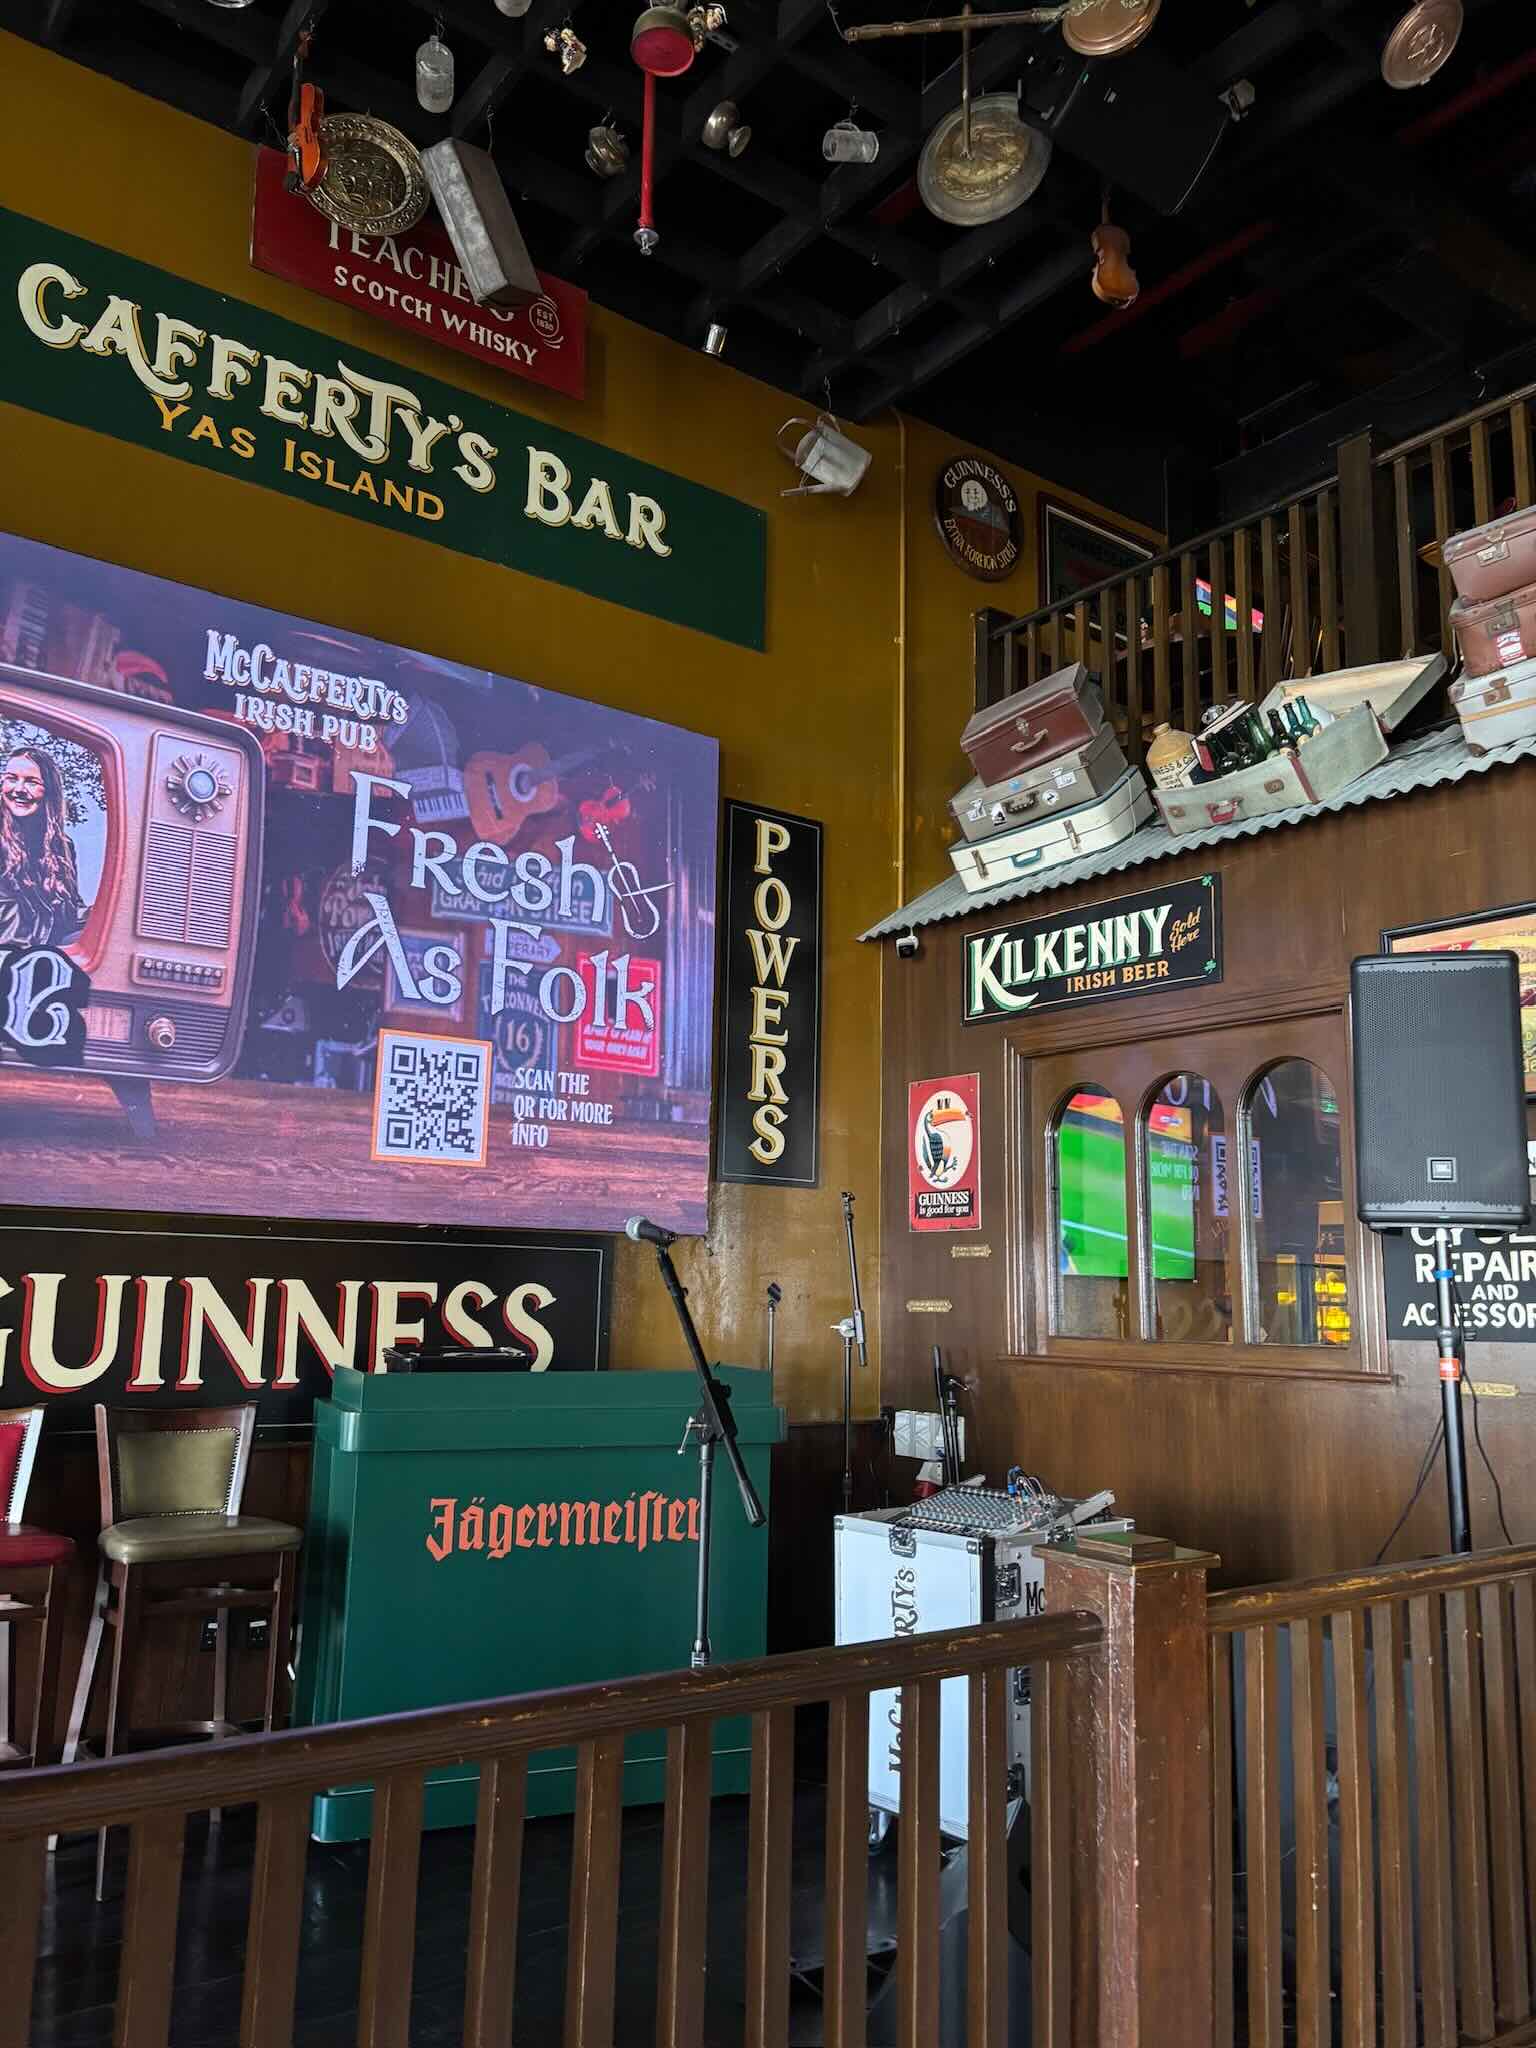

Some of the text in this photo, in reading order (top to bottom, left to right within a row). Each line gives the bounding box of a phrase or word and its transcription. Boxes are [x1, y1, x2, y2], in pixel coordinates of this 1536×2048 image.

[327, 221, 514, 322] TEACHE
[333, 265, 538, 366] SCOTCH WHISKY
[17, 262, 671, 557] CAFFERTY'S BAR
[151, 393, 445, 522] YAS ISLAND
[233, 693, 378, 753] IRISH PUB
[336, 892, 462, 1004] As
[489, 918, 656, 1032] Folk
[970, 904, 1201, 1016] KILKENNY Sold
[1066, 959, 1170, 994] IRISH BEER
[747, 819, 800, 1166] POWERS
[505, 1018, 530, 1052] 16
[513, 1067, 555, 1092] SCAN
[558, 1072, 590, 1096] THE
[512, 1095, 613, 1125] QR FOR MORE
[511, 1122, 549, 1148] INFO
[918, 1191, 969, 1206] GUINNESS
[919, 1204, 969, 1217] is good for you
[1402, 1302, 1536, 1329] ACESSOR
[1471, 1284, 1519, 1301] AND
[0, 1272, 557, 1394] UINNESS
